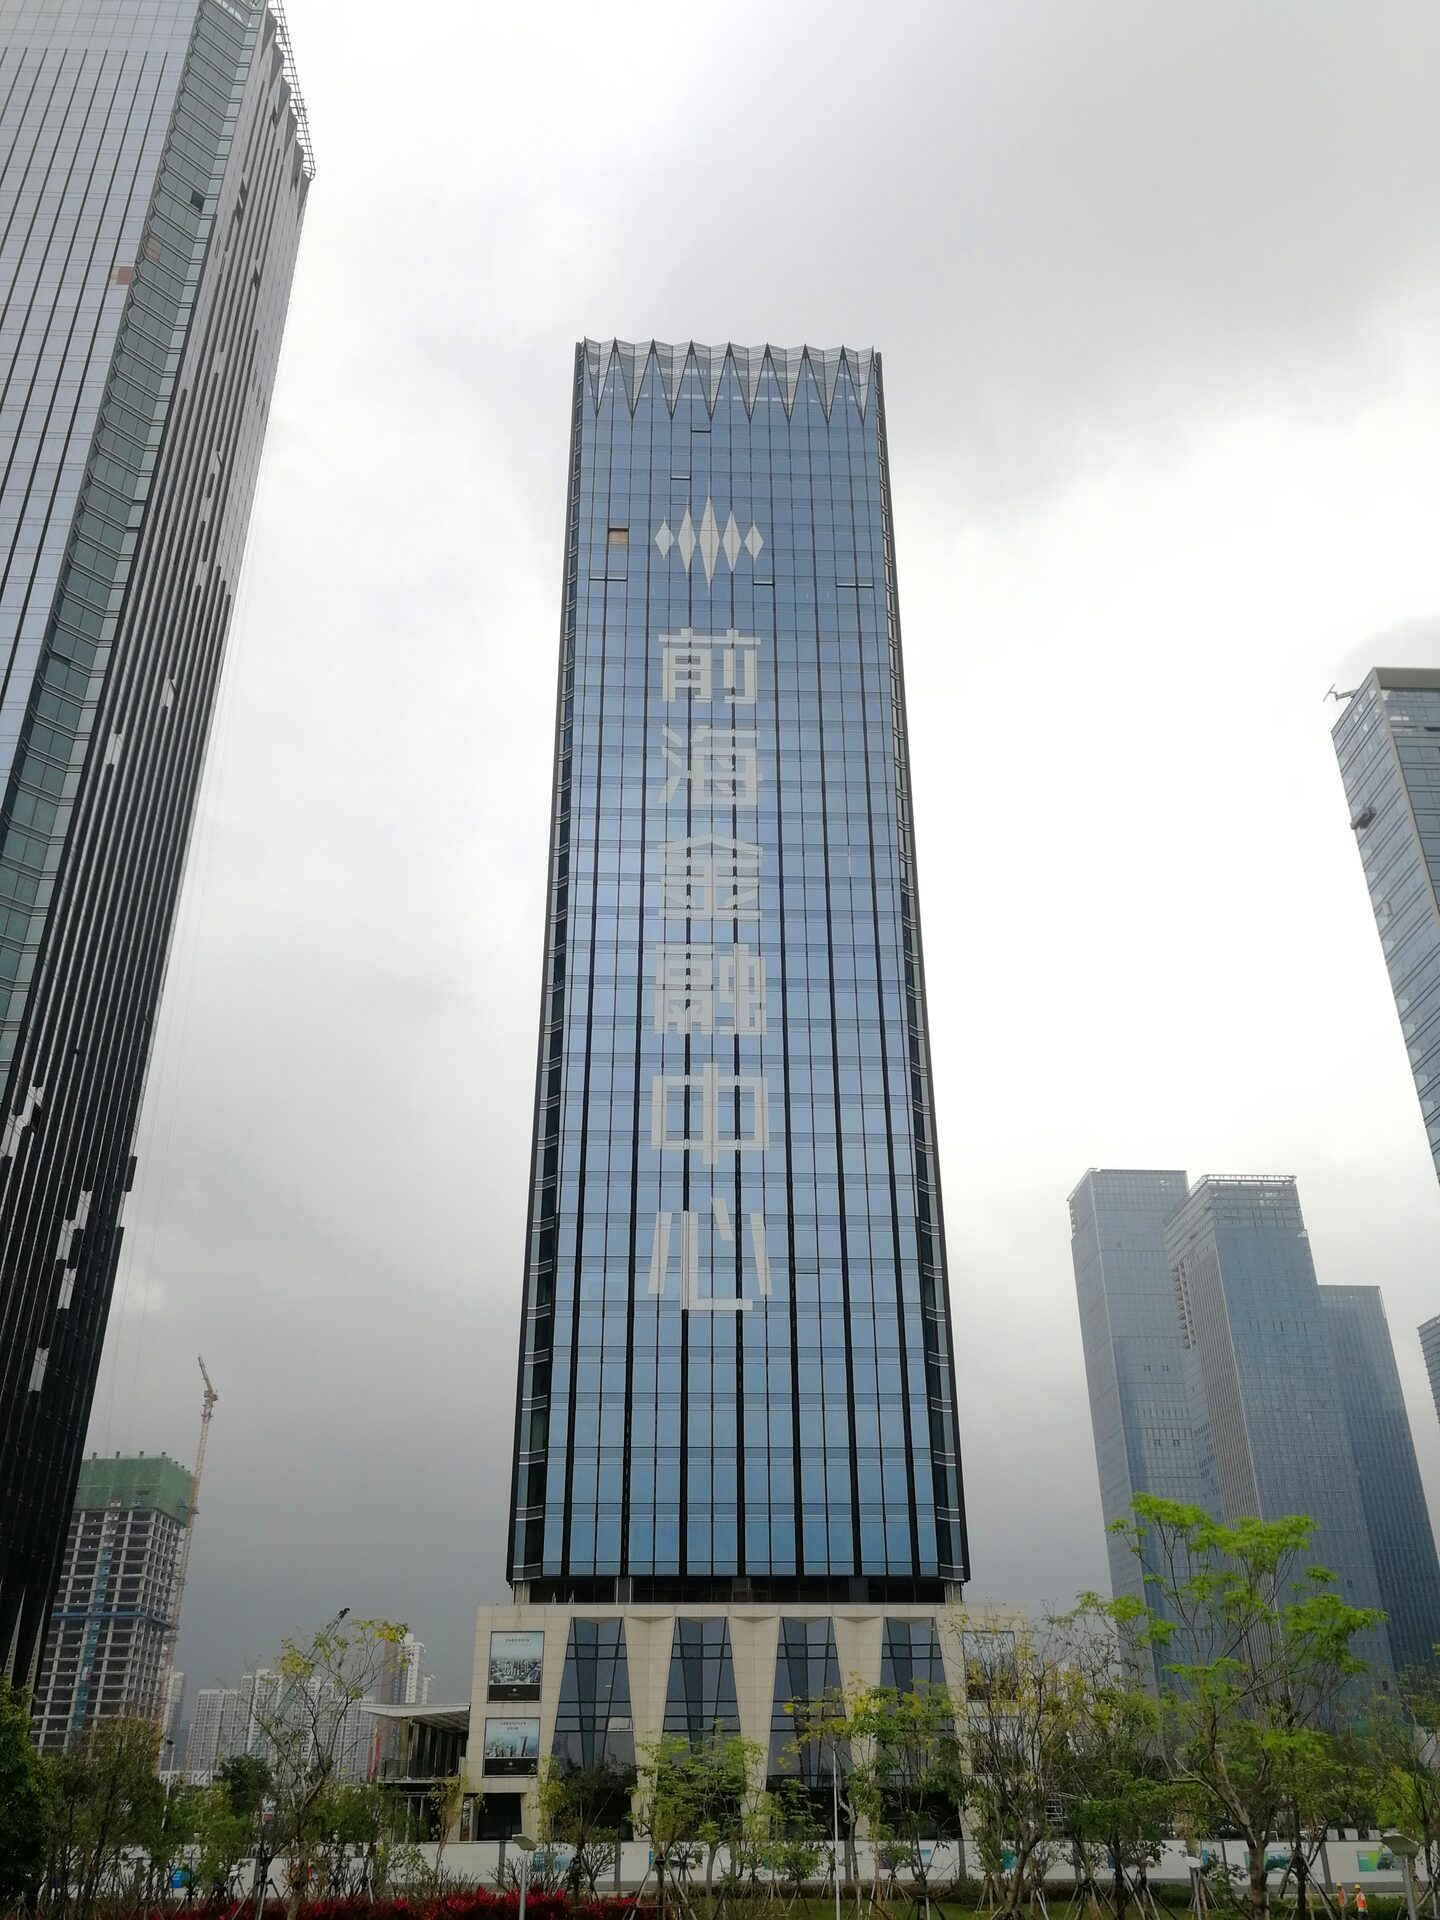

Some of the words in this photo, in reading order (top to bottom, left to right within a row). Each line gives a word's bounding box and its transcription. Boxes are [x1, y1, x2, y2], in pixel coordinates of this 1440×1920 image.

[648, 628, 773, 1311] 前海金融中心
